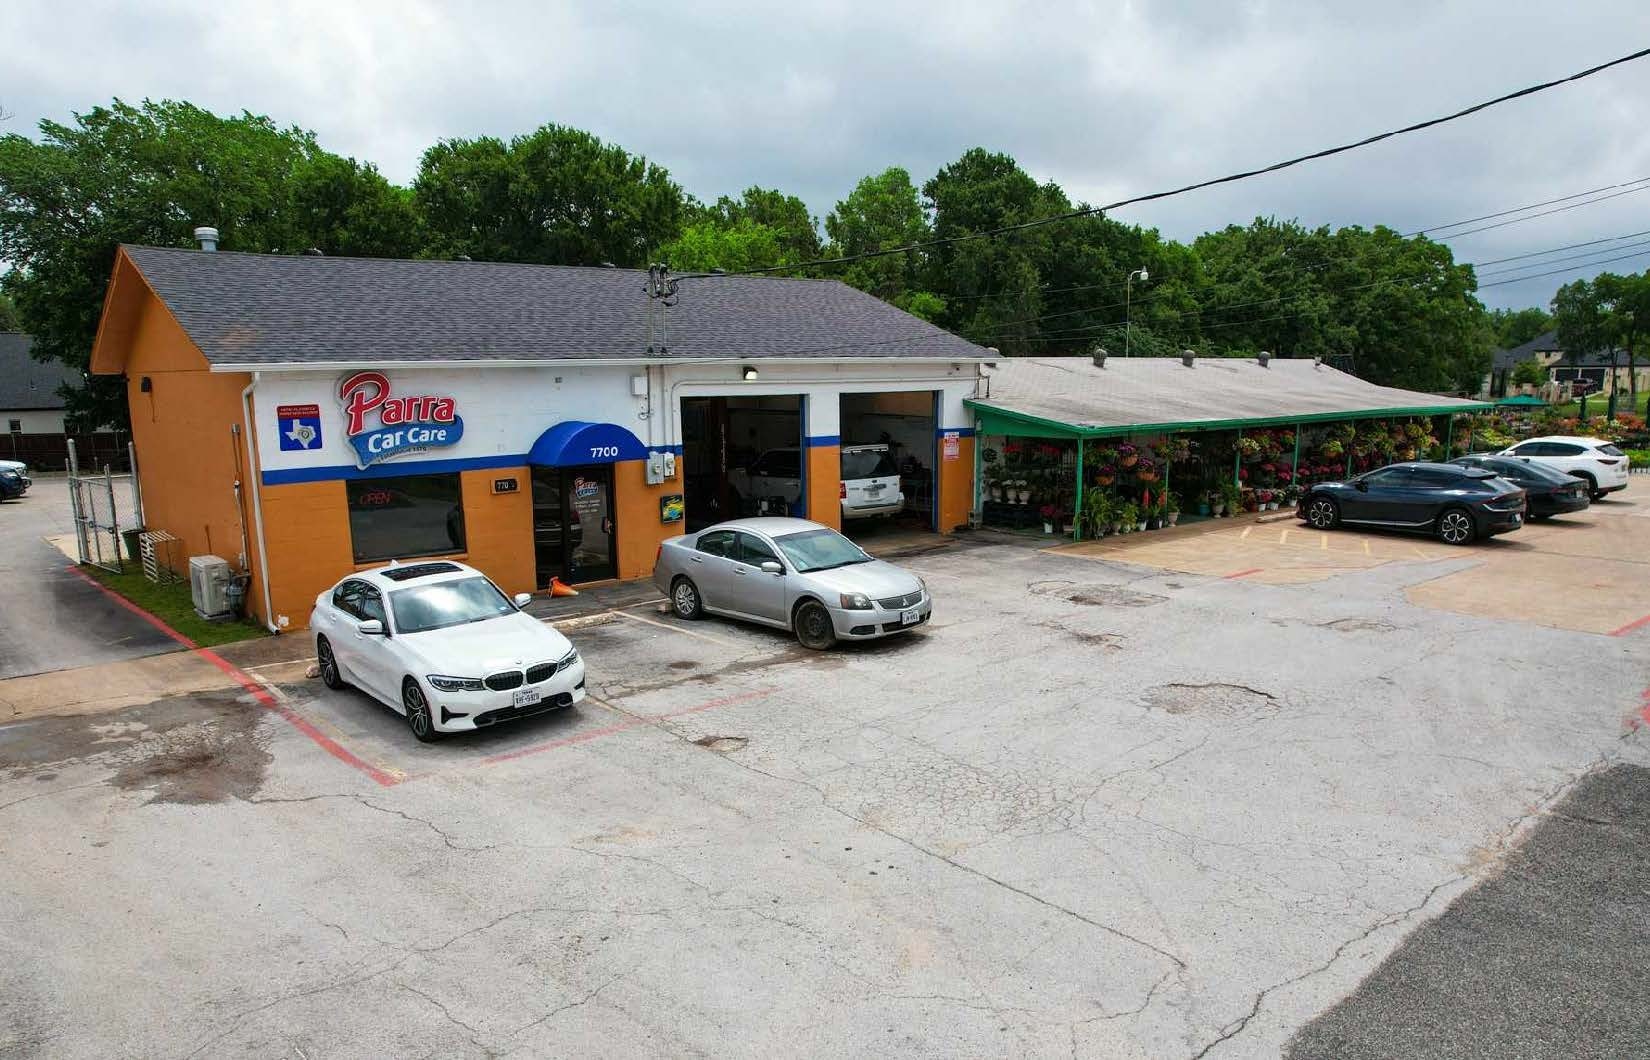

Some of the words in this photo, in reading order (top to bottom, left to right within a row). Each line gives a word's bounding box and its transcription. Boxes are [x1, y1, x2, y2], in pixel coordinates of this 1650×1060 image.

[342, 371, 456, 436] Parra
[368, 431, 404, 453] Car
[407, 427, 447, 443] Care
[590, 446, 619, 458] 7700
